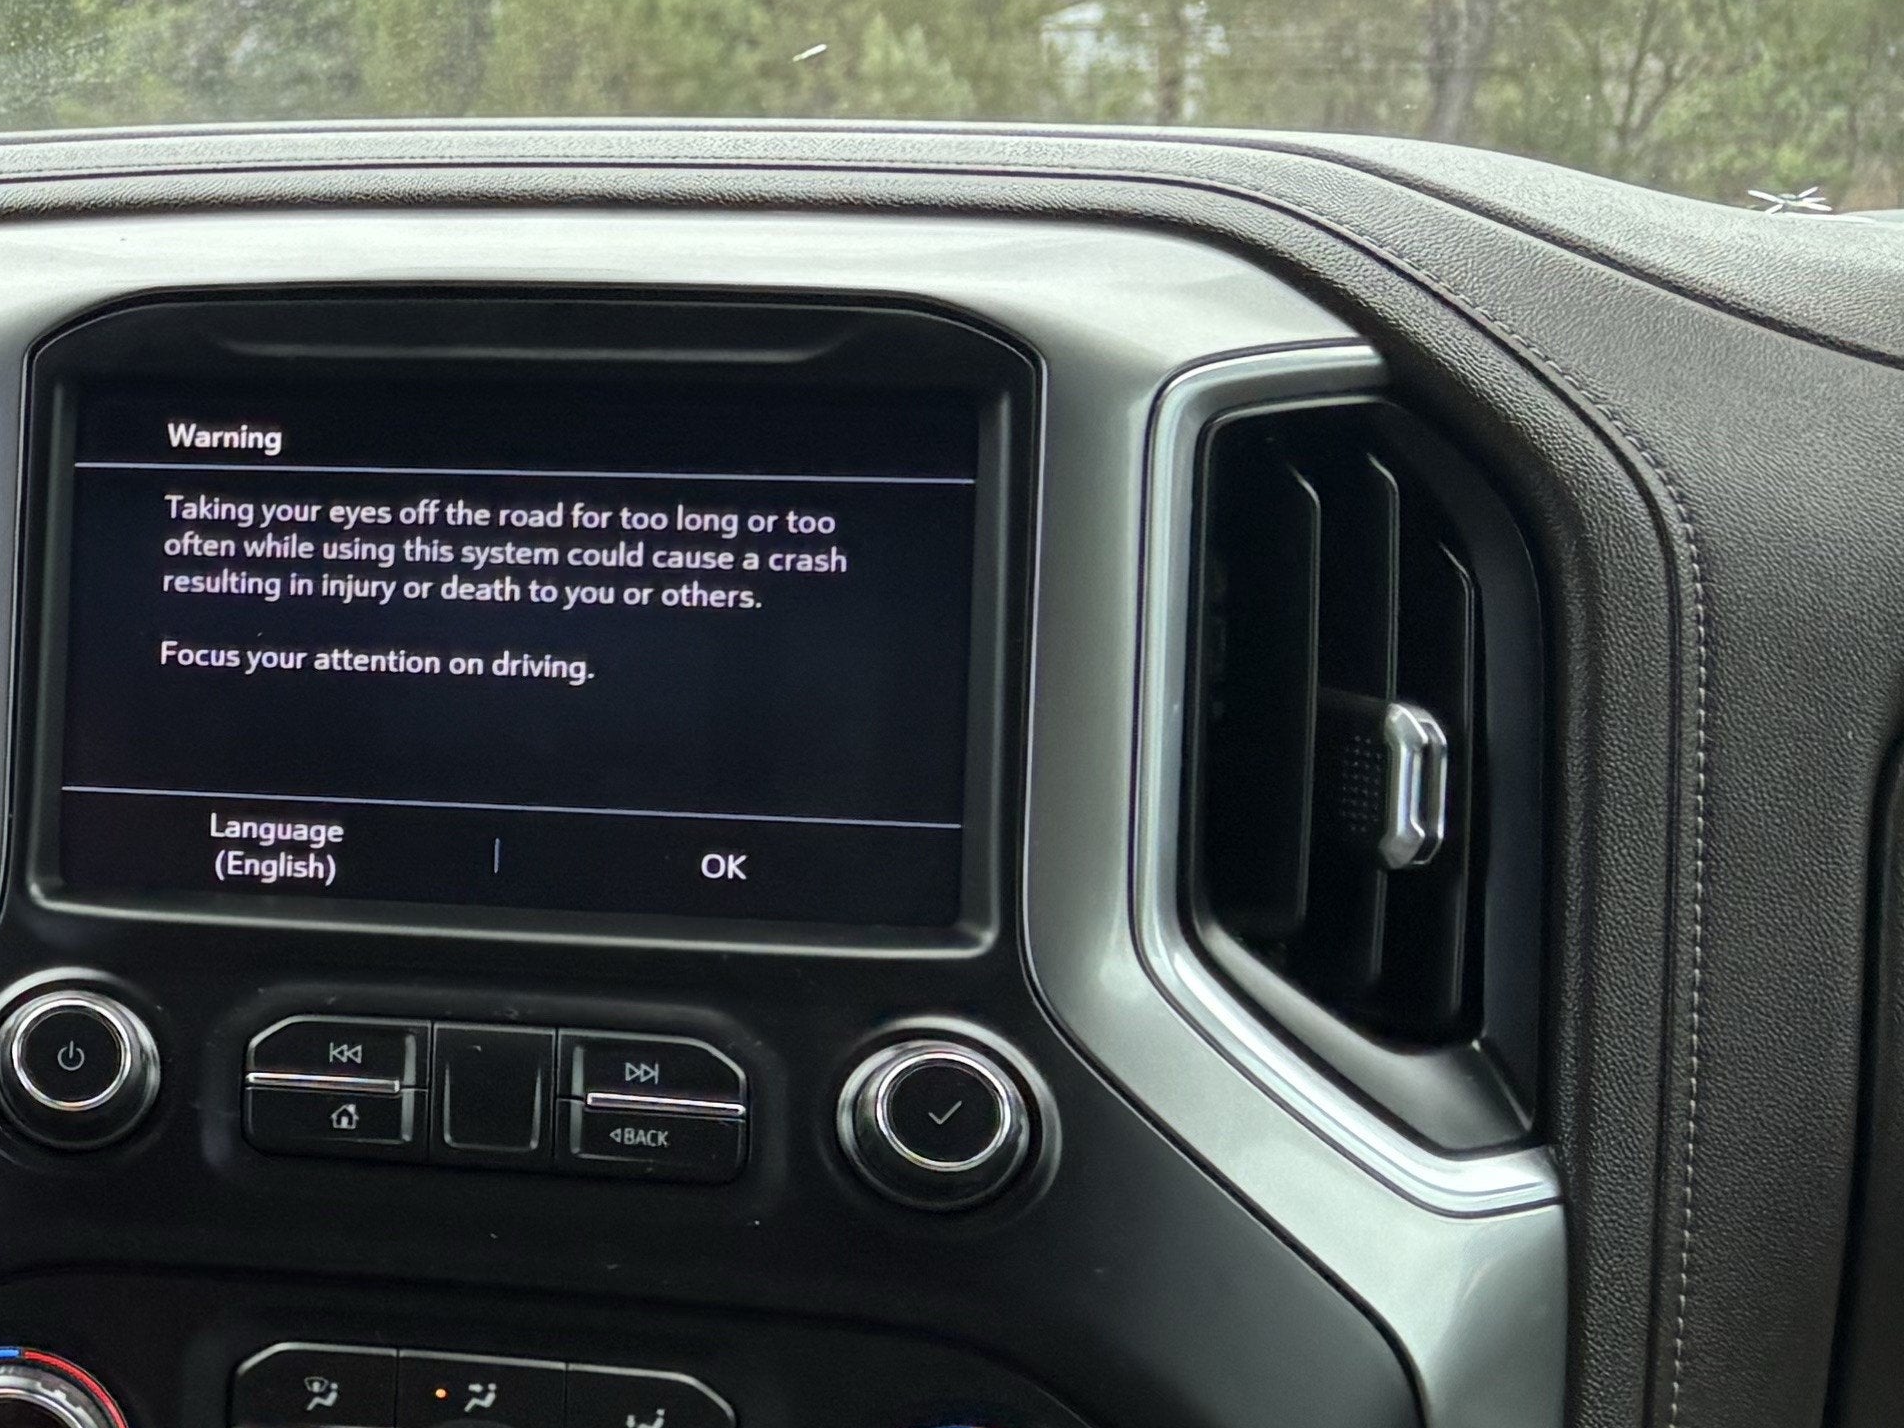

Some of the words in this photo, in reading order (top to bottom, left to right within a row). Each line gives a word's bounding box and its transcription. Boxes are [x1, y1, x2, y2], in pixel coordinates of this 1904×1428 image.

[167, 422, 282, 456] Warning
[164, 494, 254, 528] Taking
[259, 503, 322, 528] your
[329, 505, 392, 530] eyes
[399, 498, 441, 525] off
[445, 499, 491, 526] the
[499, 501, 564, 528] road
[571, 502, 613, 529] for
[619, 507, 669, 530] too
[676, 504, 739, 539] long
[747, 514, 779, 534] or
[786, 510, 836, 534] too
[164, 530, 236, 557] often
[243, 532, 315, 559] while
[322, 537, 396, 568] using
[402, 535, 455, 563] this
[460, 541, 559, 571] system
[567, 540, 644, 568] could
[652, 550, 735, 570] cause
[742, 552, 760, 571] a
[768, 546, 848, 573] crash
[163, 567, 281, 602] resulting
[289, 572, 314, 596] in
[321, 573, 397, 605] injury
[403, 581, 434, 599] or
[440, 574, 521, 602] death
[528, 579, 558, 603] to
[562, 586, 615, 611] you
[623, 587, 654, 606] or
[661, 580, 763, 609] others.
[160, 640, 241, 668] Focus
[245, 650, 308, 675] your
[313, 648, 441, 674] attention
[448, 657, 484, 676] on
[491, 650, 595, 686] driving.
[210, 812, 344, 849] Language
[215, 849, 336, 886] (English)
[701, 853, 747, 880] OK
[623, 1127, 670, 1148] BACK
